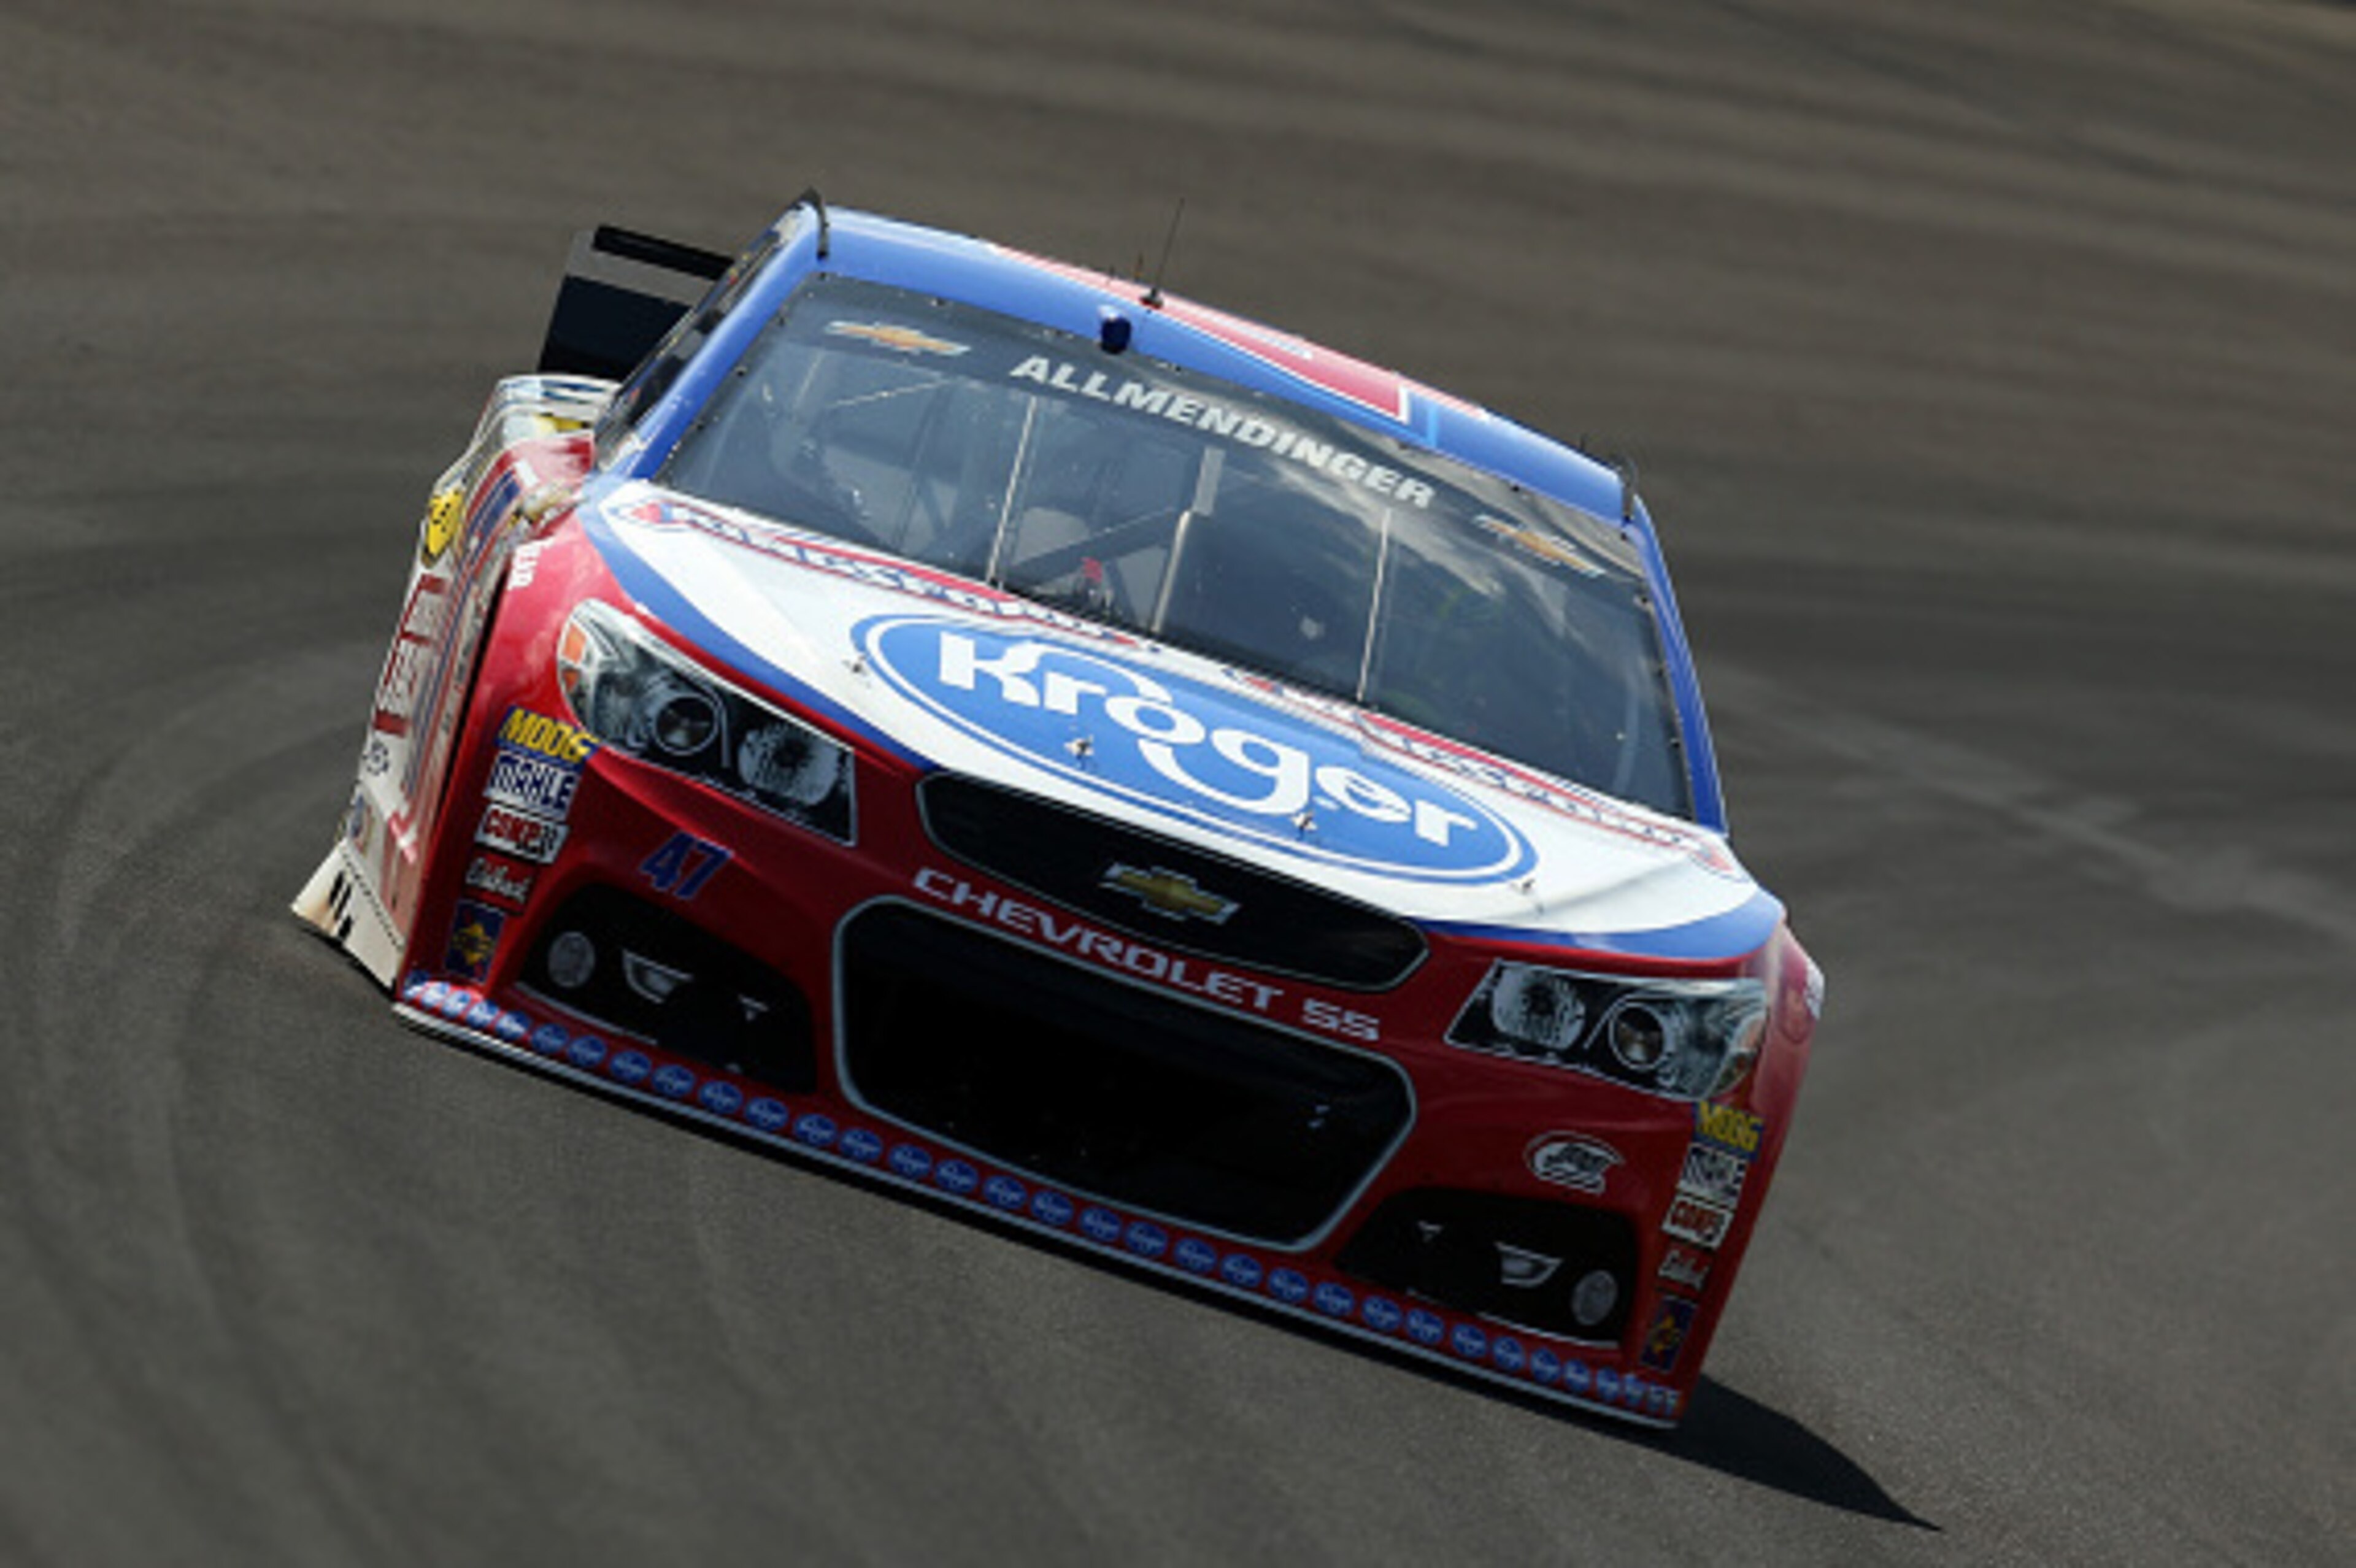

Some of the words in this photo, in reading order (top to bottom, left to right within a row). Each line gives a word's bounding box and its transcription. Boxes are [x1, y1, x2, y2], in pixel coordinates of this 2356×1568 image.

[1011, 356, 1434, 508] ALLMENDINGER
[499, 708, 599, 763] MOOG
[939, 630, 1479, 848] Kroger
[639, 829, 734, 899] 47
[912, 867, 1285, 1013] CHEVROLET
[1695, 1101, 1764, 1151] MOOG
